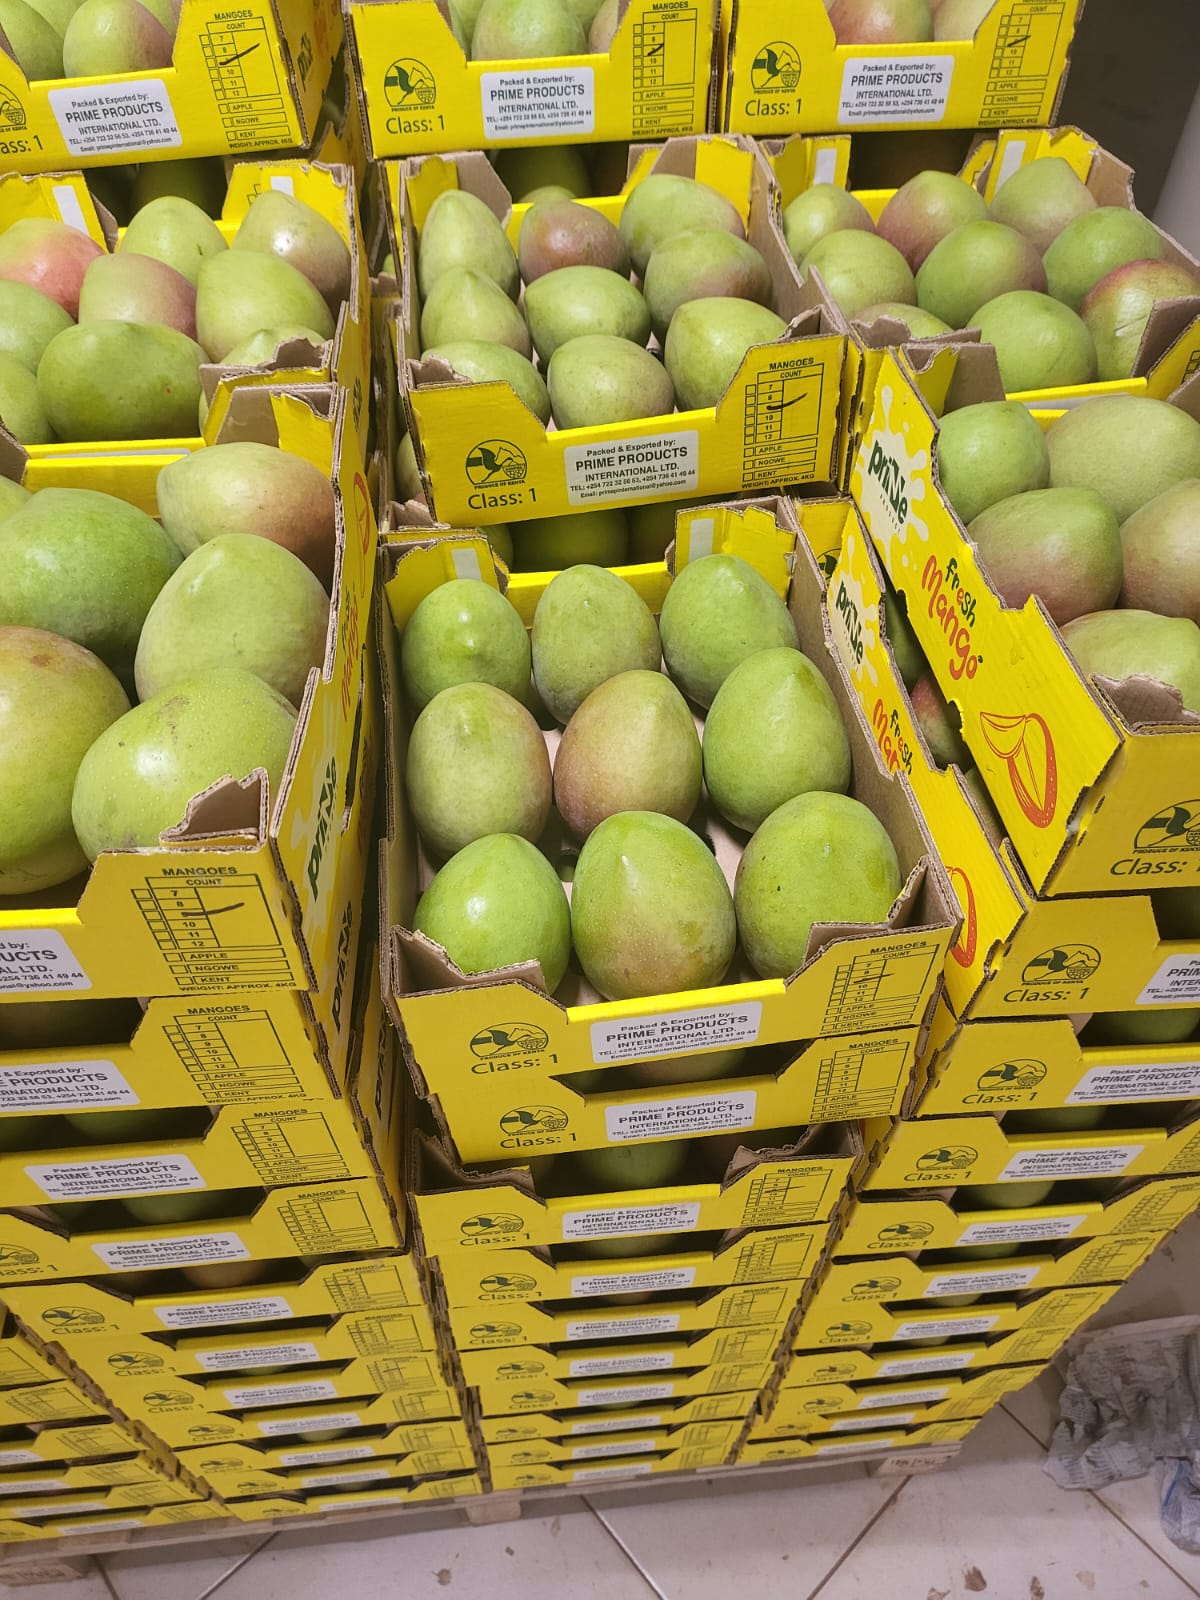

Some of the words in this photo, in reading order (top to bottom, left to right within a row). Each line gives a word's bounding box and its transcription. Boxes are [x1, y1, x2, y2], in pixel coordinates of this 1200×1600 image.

[652, 1, 688, 10] MANGOES
[214, 10, 253, 20] MANGOES
[863, 64, 887, 72] Packed
[895, 63, 924, 71] Exported
[925, 63, 936, 71] by:
[500, 78, 524, 86] Packed
[533, 76, 563, 84] Exported
[564, 75, 575, 83] by:
[851, 75, 883, 86] PRIME
[886, 72, 942, 85] PRODUCTS
[490, 88, 523, 101] PRIME
[526, 84, 584, 98] PRODUCTS
[856, 89, 915, 99] INTERNATIONAL
[917, 88, 933, 97] LTD.
[71, 99, 97, 108] Packed
[105, 94, 137, 104] Exported
[137, 93, 149, 101] by:
[499, 102, 560, 113] INTERNATIONAL
[562, 100, 578, 109] LTD.
[745, 99, 789, 116] Class:
[796, 98, 802, 114] 1
[65, 109, 101, 123] PRIME
[102, 102, 163, 118] PRODUCTS
[78, 121, 142, 135] INTERNATIONAL
[143, 118, 161, 127] LTD.
[386, 117, 432, 134] Class:
[438, 115, 445, 131] 1
[0, 140, 31, 154] ass:
[33, 135, 44, 151] 1
[770, 358, 813, 370] MANGOES
[780, 370, 801, 379] COUNT
[587, 447, 616, 457] Packed
[626, 441, 662, 451] Exported
[758, 445, 782, 453] APPLE
[576, 457, 614, 471] PRIME
[618, 447, 687, 465] PRODUCTS
[585, 466, 657, 481] INTERNATIONAL
[660, 462, 679, 472] LTD.
[468, 493, 522, 509] Class:
[529, 488, 536, 502] 1
[945, 557, 976, 627] fresh
[162, 867, 237, 876] MANGOES
[1110, 858, 1187, 875] Class:
[870, 941, 926, 954] MANGOES
[18, 965, 52, 973] LTD.
[1004, 989, 1070, 1002] Class:
[1080, 987, 1089, 999] 1
[187, 1005, 250, 1015] MANGOES
[606, 1029, 655, 1042] PRIME
[661, 1016, 747, 1034] PRODUCTS
[621, 1022, 657, 1032] Packed
[671, 1014, 716, 1025] Exported
[618, 1031, 709, 1048] INTERNATIONAL
[848, 1039, 898, 1049] MANGOES
[471, 1059, 540, 1074] Class:
[549, 1054, 558, 1064] 1
[10, 1073, 107, 1086] PRODUCTS
[15, 1069, 65, 1077] Exported
[1091, 1075, 1134, 1083] PRIME
[962, 1094, 1021, 1104] Class:
[1029, 1092, 1038, 1101] 1
[253, 1109, 308, 1118] MANGOES
[619, 1113, 662, 1124] PRIME
[667, 1104, 744, 1118] PRODUCTS
[632, 1107, 664, 1115] Packed
[676, 1101, 716, 1110] Exported
[629, 1116, 710, 1129] INTERNATIONAL
[500, 1137, 560, 1148] Class:
[569, 1132, 576, 1141] 1
[1060, 1153, 1127, 1162] PRODUCTS
[44, 1172, 93, 1181] PRIME
[95, 1165, 180, 1177] PRODUCTS
[904, 1173, 957, 1181] Class:
[965, 1171, 972, 1179] 1
[61, 1176, 150, 1187] INTERNATIONAL
[574, 1216, 613, 1224] PRIME
[617, 1210, 688, 1220] PRODUCTS
[460, 1236, 515, 1246] Class:
[108, 1248, 151, 1257] PRIME
[154, 1241, 229, 1252] PRODUCTS
